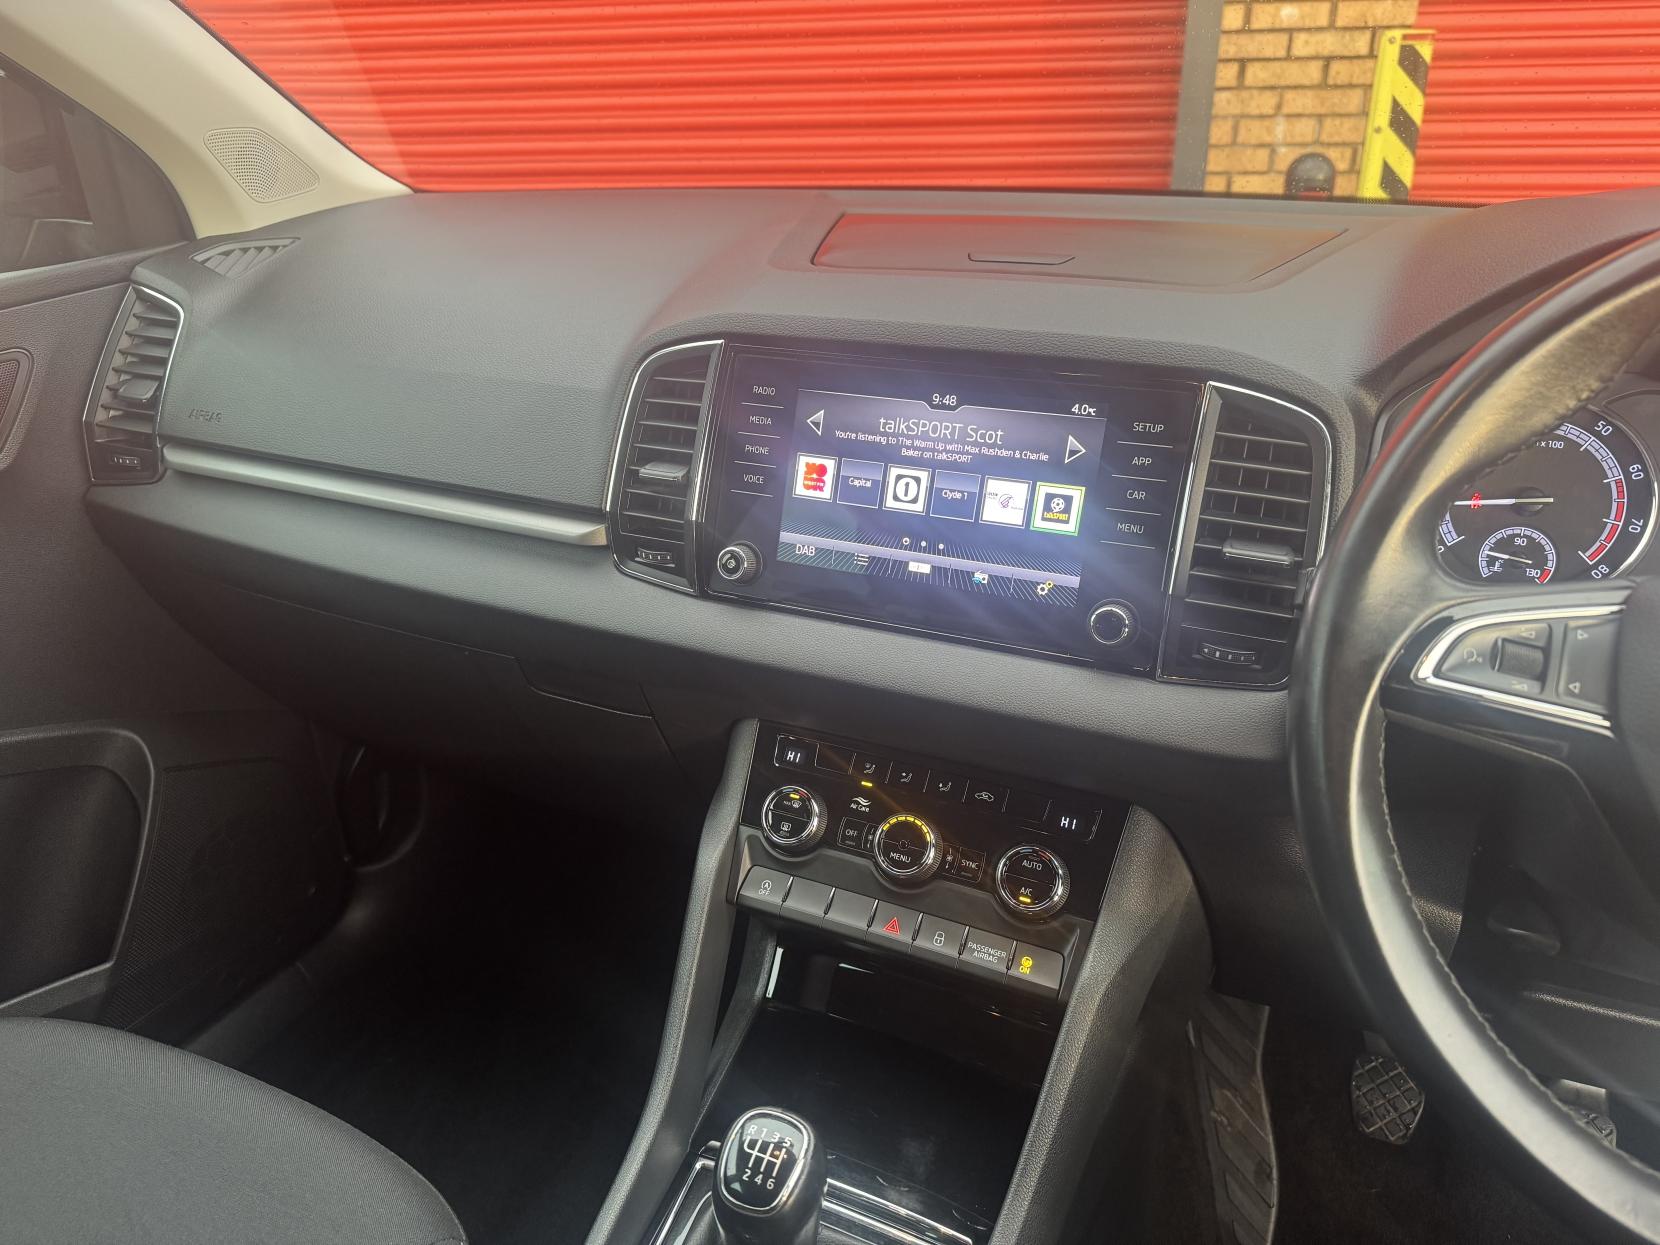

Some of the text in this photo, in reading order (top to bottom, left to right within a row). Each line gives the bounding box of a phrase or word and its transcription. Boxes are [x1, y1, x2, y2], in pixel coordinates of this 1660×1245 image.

[753, 386, 776, 396] RADIO
[932, 394, 956, 406] 9:48
[750, 416, 772, 426] MEDIA
[880, 417, 1004, 444] talkSPORT Scot
[1133, 422, 1164, 434] SETUP
[1594, 420, 1613, 436] 50
[744, 444, 770, 455] PHONE
[858, 432, 887, 444] listening
[889, 436, 896, 444] to
[898, 437, 912, 446] The
[914, 439, 934, 448] Warm
[935, 441, 944, 450] Up
[946, 443, 962, 452] with
[964, 444, 980, 454] Max
[981, 446, 1013, 458] Rushden
[1014, 450, 1020, 458] &
[1022, 451, 1049, 462] Charlie
[1548, 440, 1564, 448] 100
[902, 448, 922, 458] Baker
[934, 451, 972, 462] talkSPORT
[1132, 456, 1152, 466] APP
[1628, 464, 1644, 480] 60
[744, 474, 764, 484] VOICE
[848, 477, 872, 488] Capital
[942, 490, 961, 500] Clyde
[1126, 490, 1146, 500] CAR
[1117, 523, 1144, 534] MENU
[1628, 518, 1643, 533] 70
[1514, 537, 1526, 546] 90
[795, 544, 816, 556] DAB
[1525, 568, 1540, 577] 130
[1592, 564, 1609, 579] 80
[786, 750, 800, 763] HI
[858, 804, 870, 813] Care
[1060, 816, 1077, 830] HI
[845, 828, 858, 837] OFF
[889, 851, 911, 863] MENU
[961, 858, 979, 870] SYNC
[1022, 860, 1042, 870] AUTO
[1020, 886, 1032, 896] A/C
[968, 941, 1006, 958] PASSENGER
[972, 951, 998, 963] AIRBAG
[1019, 965, 1030, 975] ON
[771, 1132, 780, 1142] 3
[742, 1169, 775, 1190] 2 4 6
